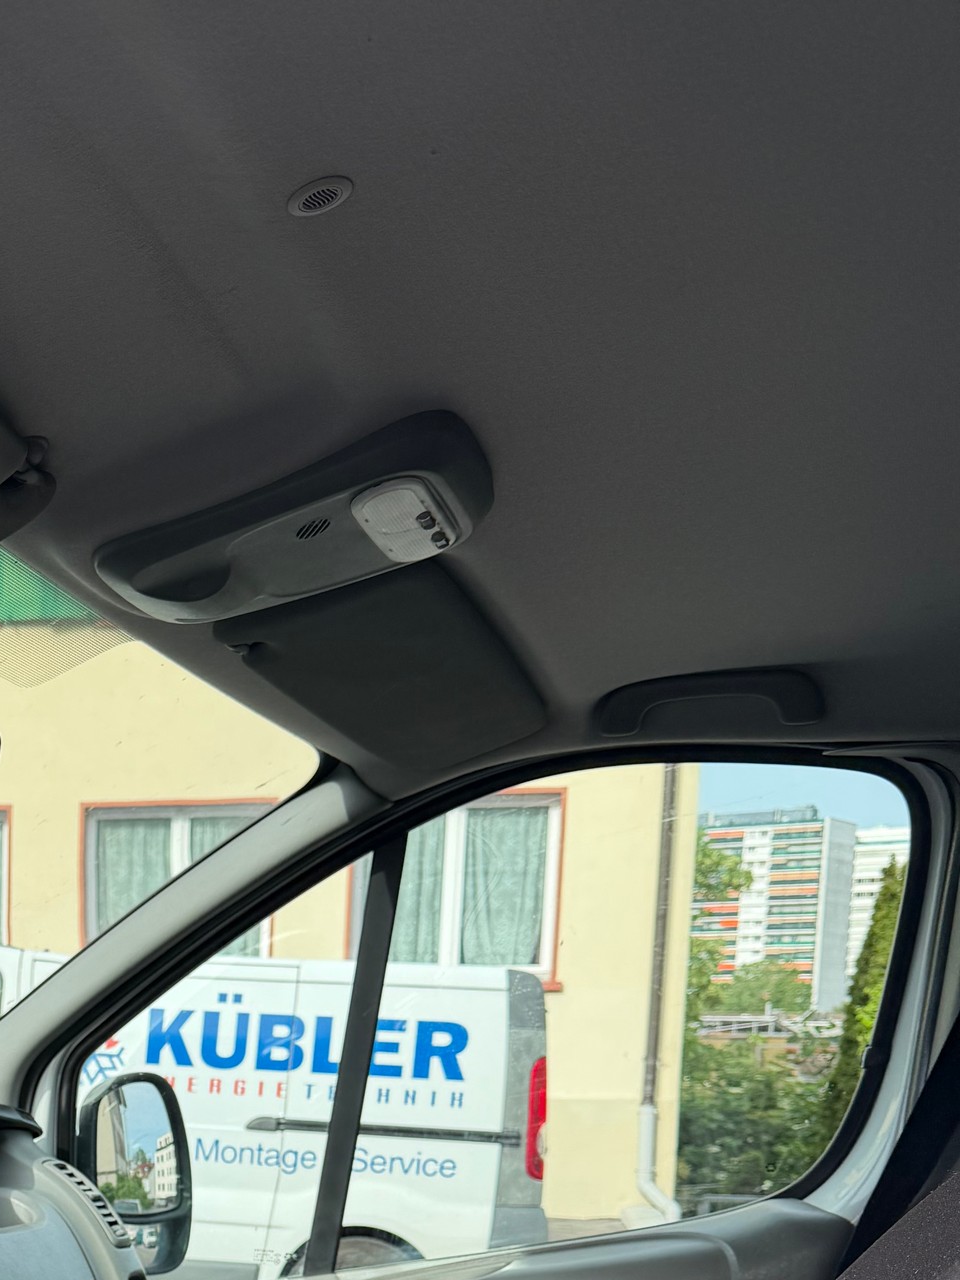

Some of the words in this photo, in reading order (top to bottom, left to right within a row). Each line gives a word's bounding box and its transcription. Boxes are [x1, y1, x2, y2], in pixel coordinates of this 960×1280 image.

[145, 993, 469, 1081] KÜBLER
[194, 1137, 318, 1175] Montage
[352, 1147, 457, 1179] Service
